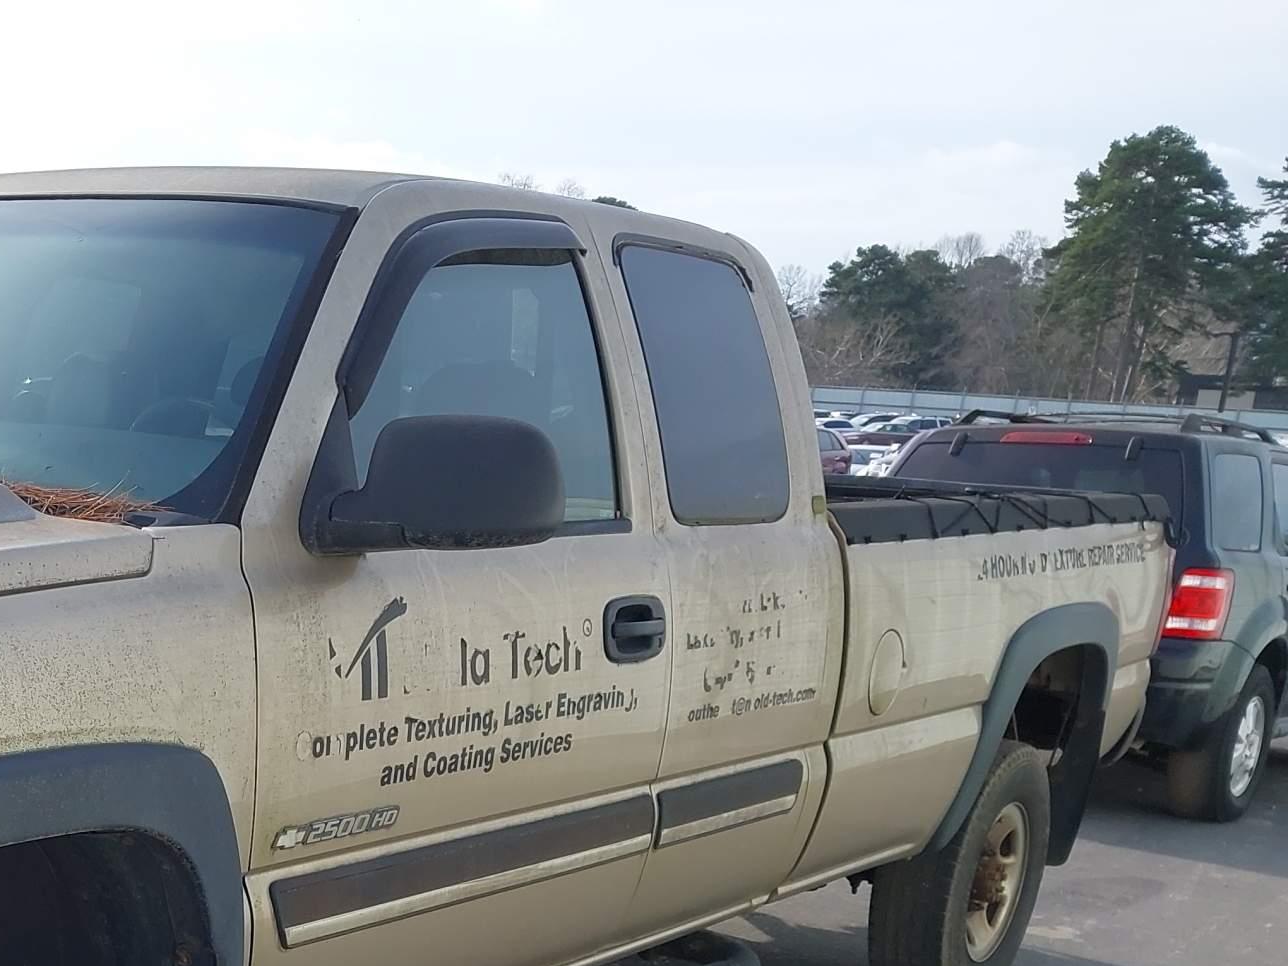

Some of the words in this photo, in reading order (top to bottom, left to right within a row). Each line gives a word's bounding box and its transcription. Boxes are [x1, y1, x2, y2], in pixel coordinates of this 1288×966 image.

[405, 706, 499, 743] Texturing,
[504, 700, 553, 726] Laser
[380, 754, 419, 787] and
[423, 744, 495, 778] Coating
[500, 732, 573, 764] Services
[306, 813, 370, 844] 2500
[371, 808, 399, 829] HD
